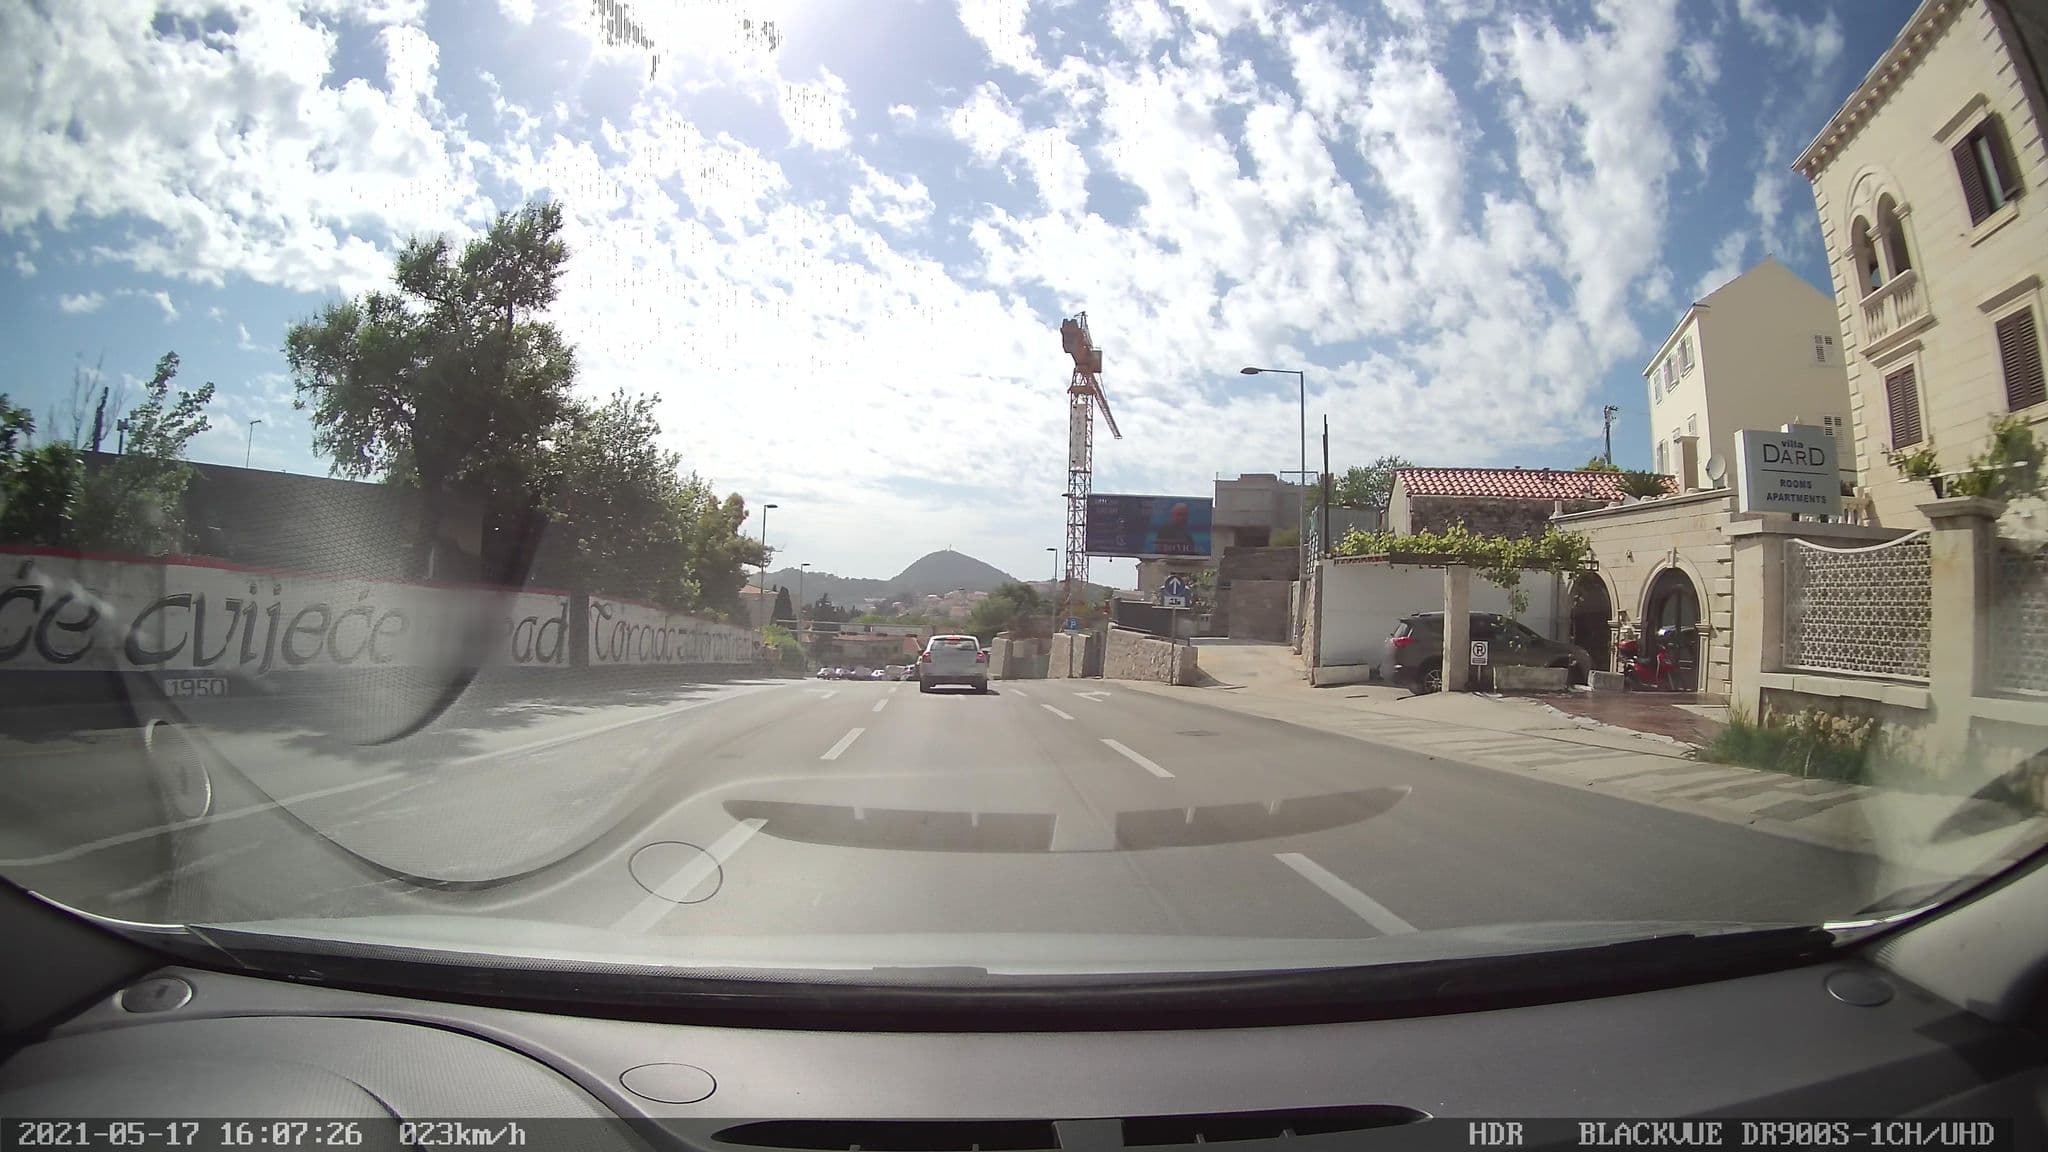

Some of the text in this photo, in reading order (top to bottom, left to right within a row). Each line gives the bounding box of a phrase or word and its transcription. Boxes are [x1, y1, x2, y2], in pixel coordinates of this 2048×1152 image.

[1781, 440, 1804, 449] villa
[1779, 478, 1813, 489] ROOMS
[1766, 492, 1827, 504] APARTMENTS
[168, 679, 226, 697] 1950
